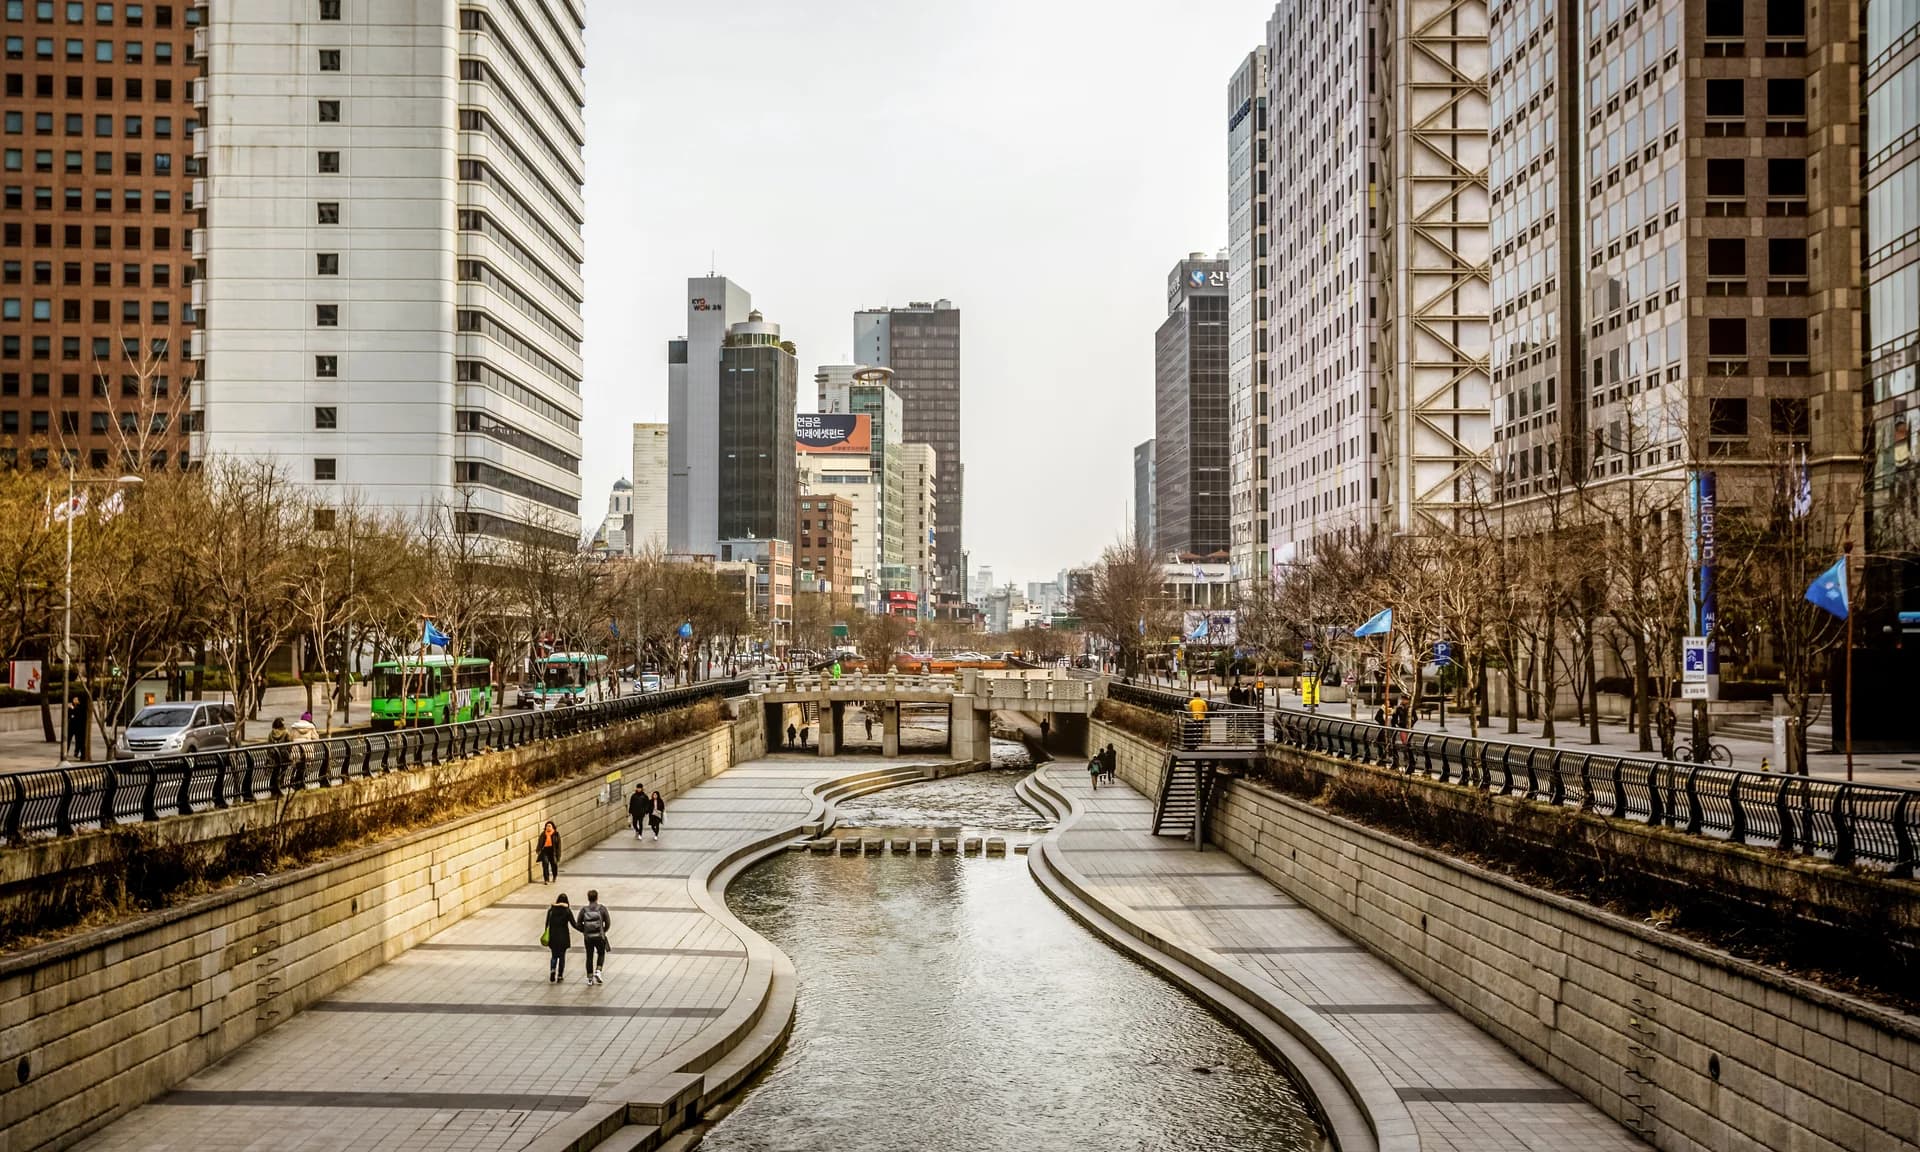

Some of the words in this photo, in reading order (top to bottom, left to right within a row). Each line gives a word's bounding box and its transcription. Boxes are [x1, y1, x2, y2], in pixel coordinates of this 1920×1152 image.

[797, 416, 821, 428] 연금은
[797, 428, 845, 439] 미래에셋펀드
[1438, 644, 1446, 655] P
